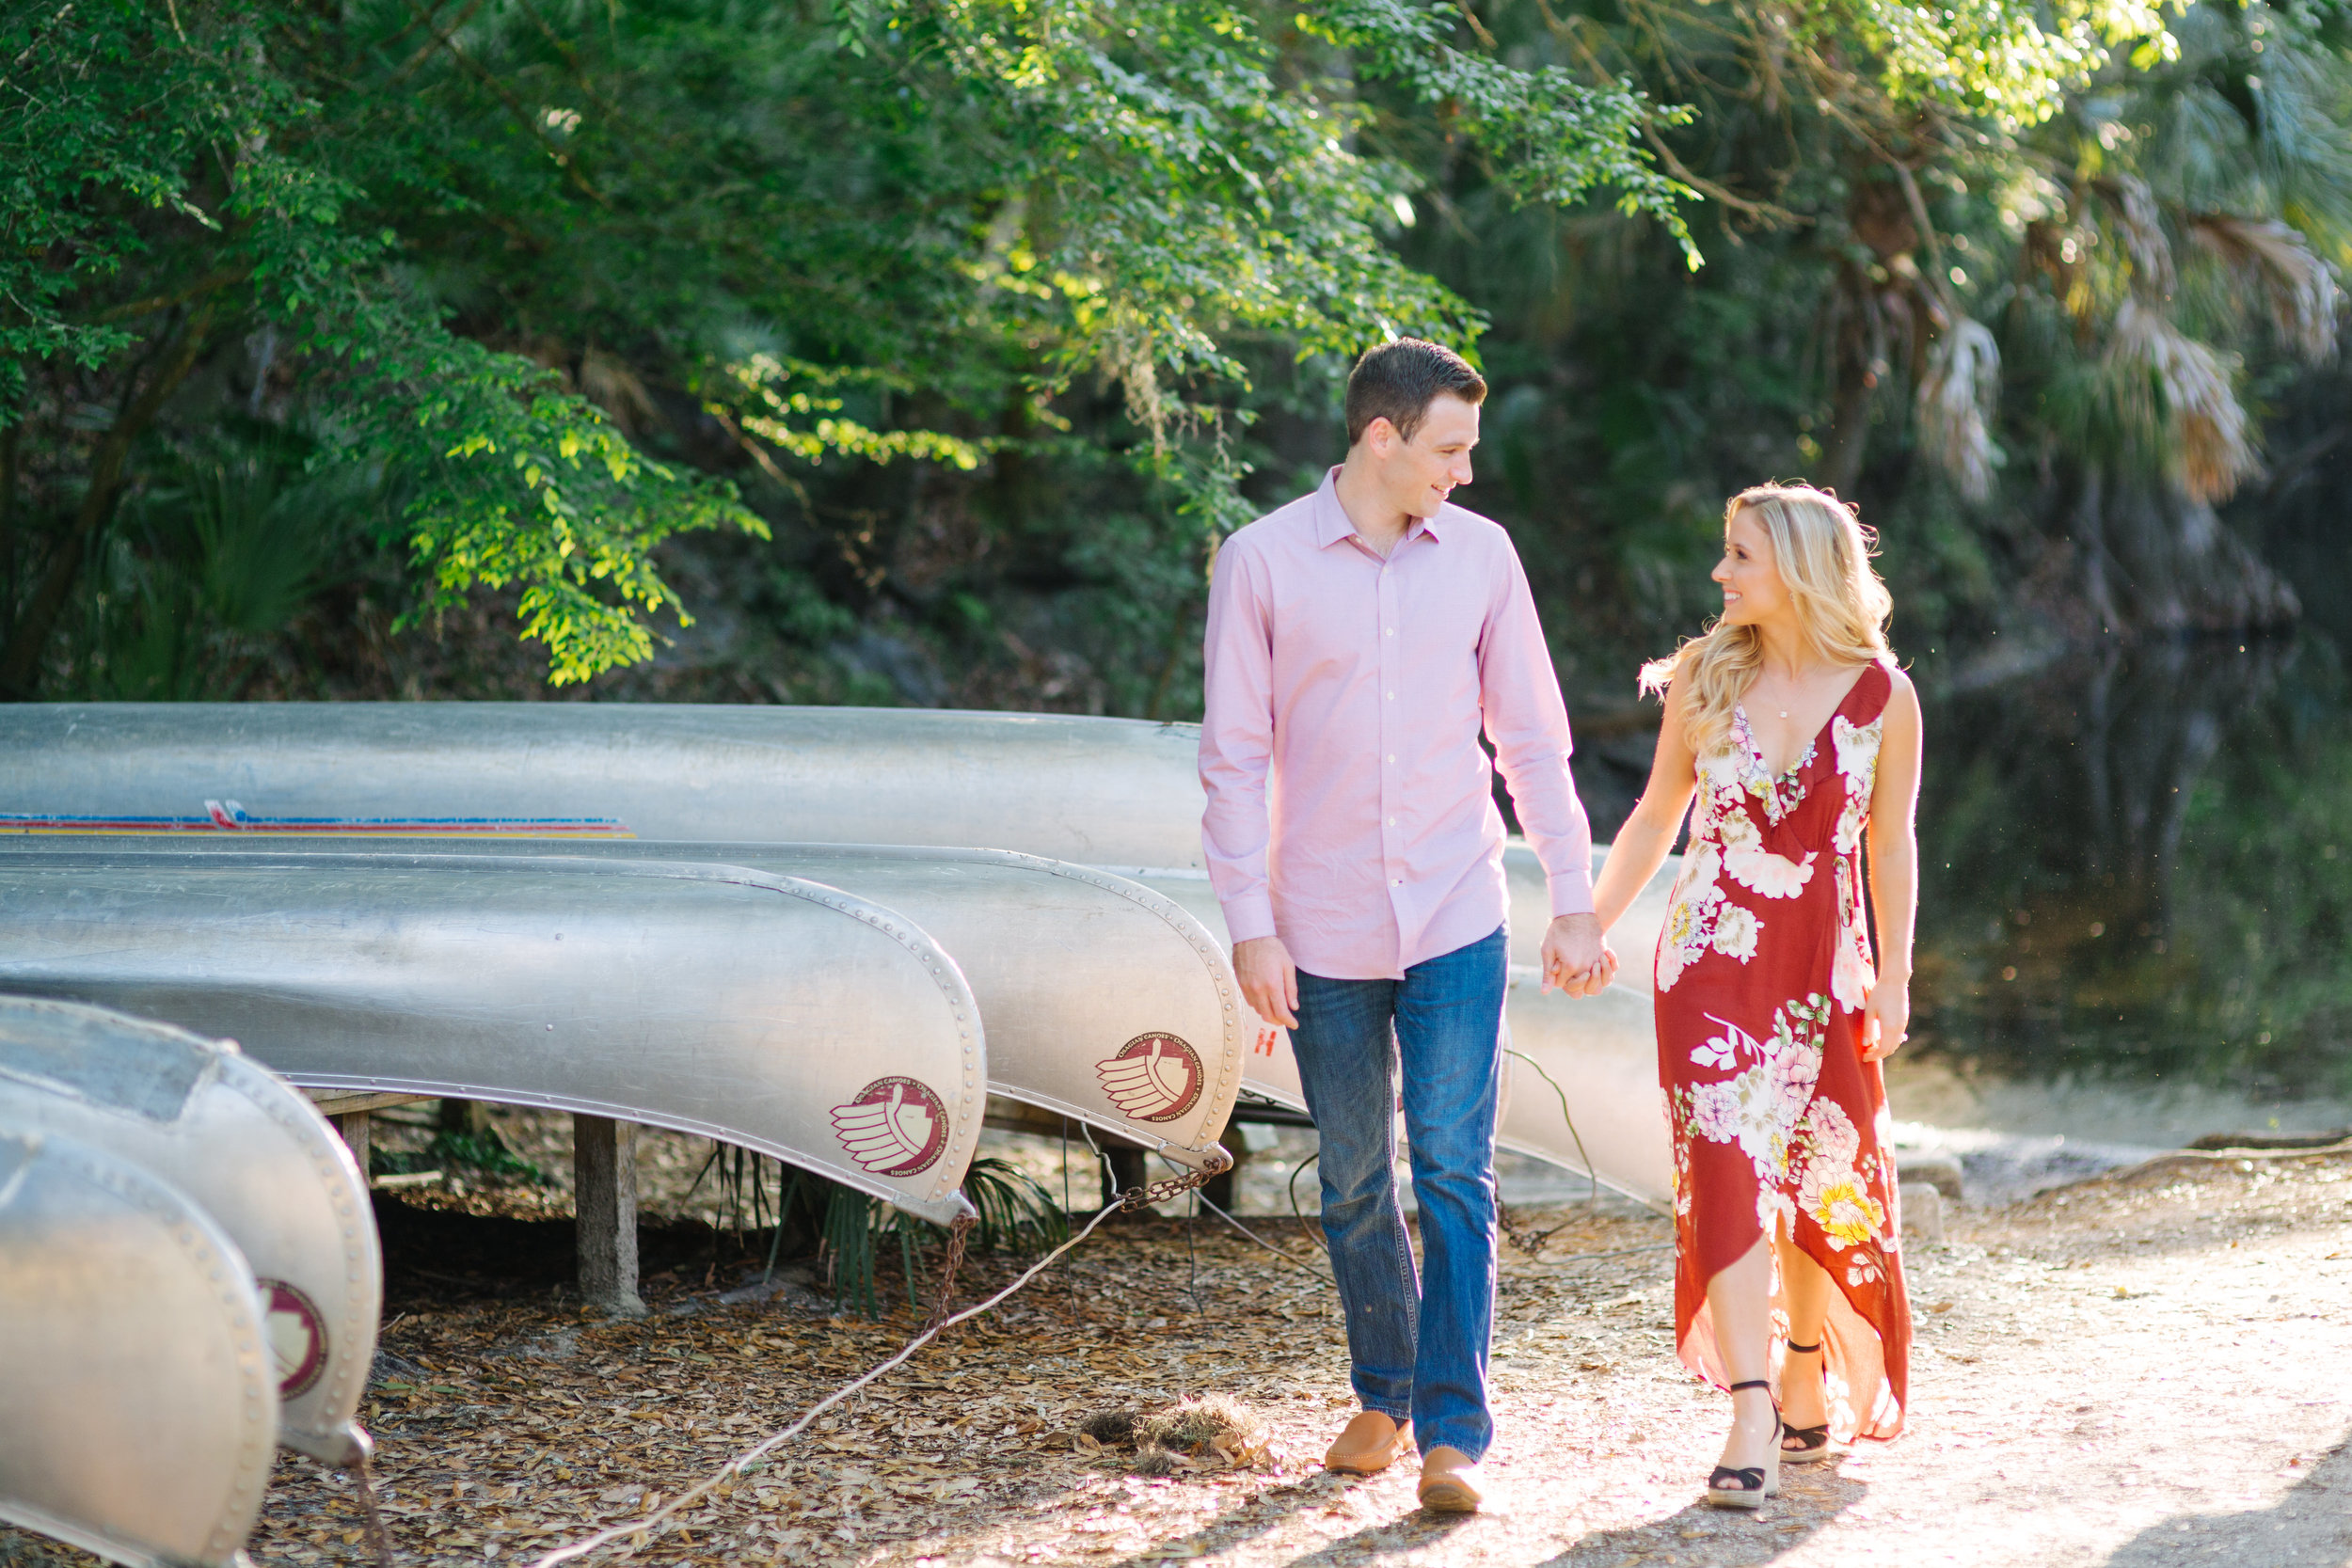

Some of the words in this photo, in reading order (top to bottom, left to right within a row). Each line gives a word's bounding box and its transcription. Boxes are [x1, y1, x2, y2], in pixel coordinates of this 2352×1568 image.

[1119, 1037, 1143, 1058] OSAGIAN
[1174, 1038, 1198, 1063] OSAGIAN
[916, 1085, 943, 1110] OSAGIAN
[1175, 1092, 1200, 1117] OSAGIAN
[914, 1146, 943, 1172] OSAGIAN
